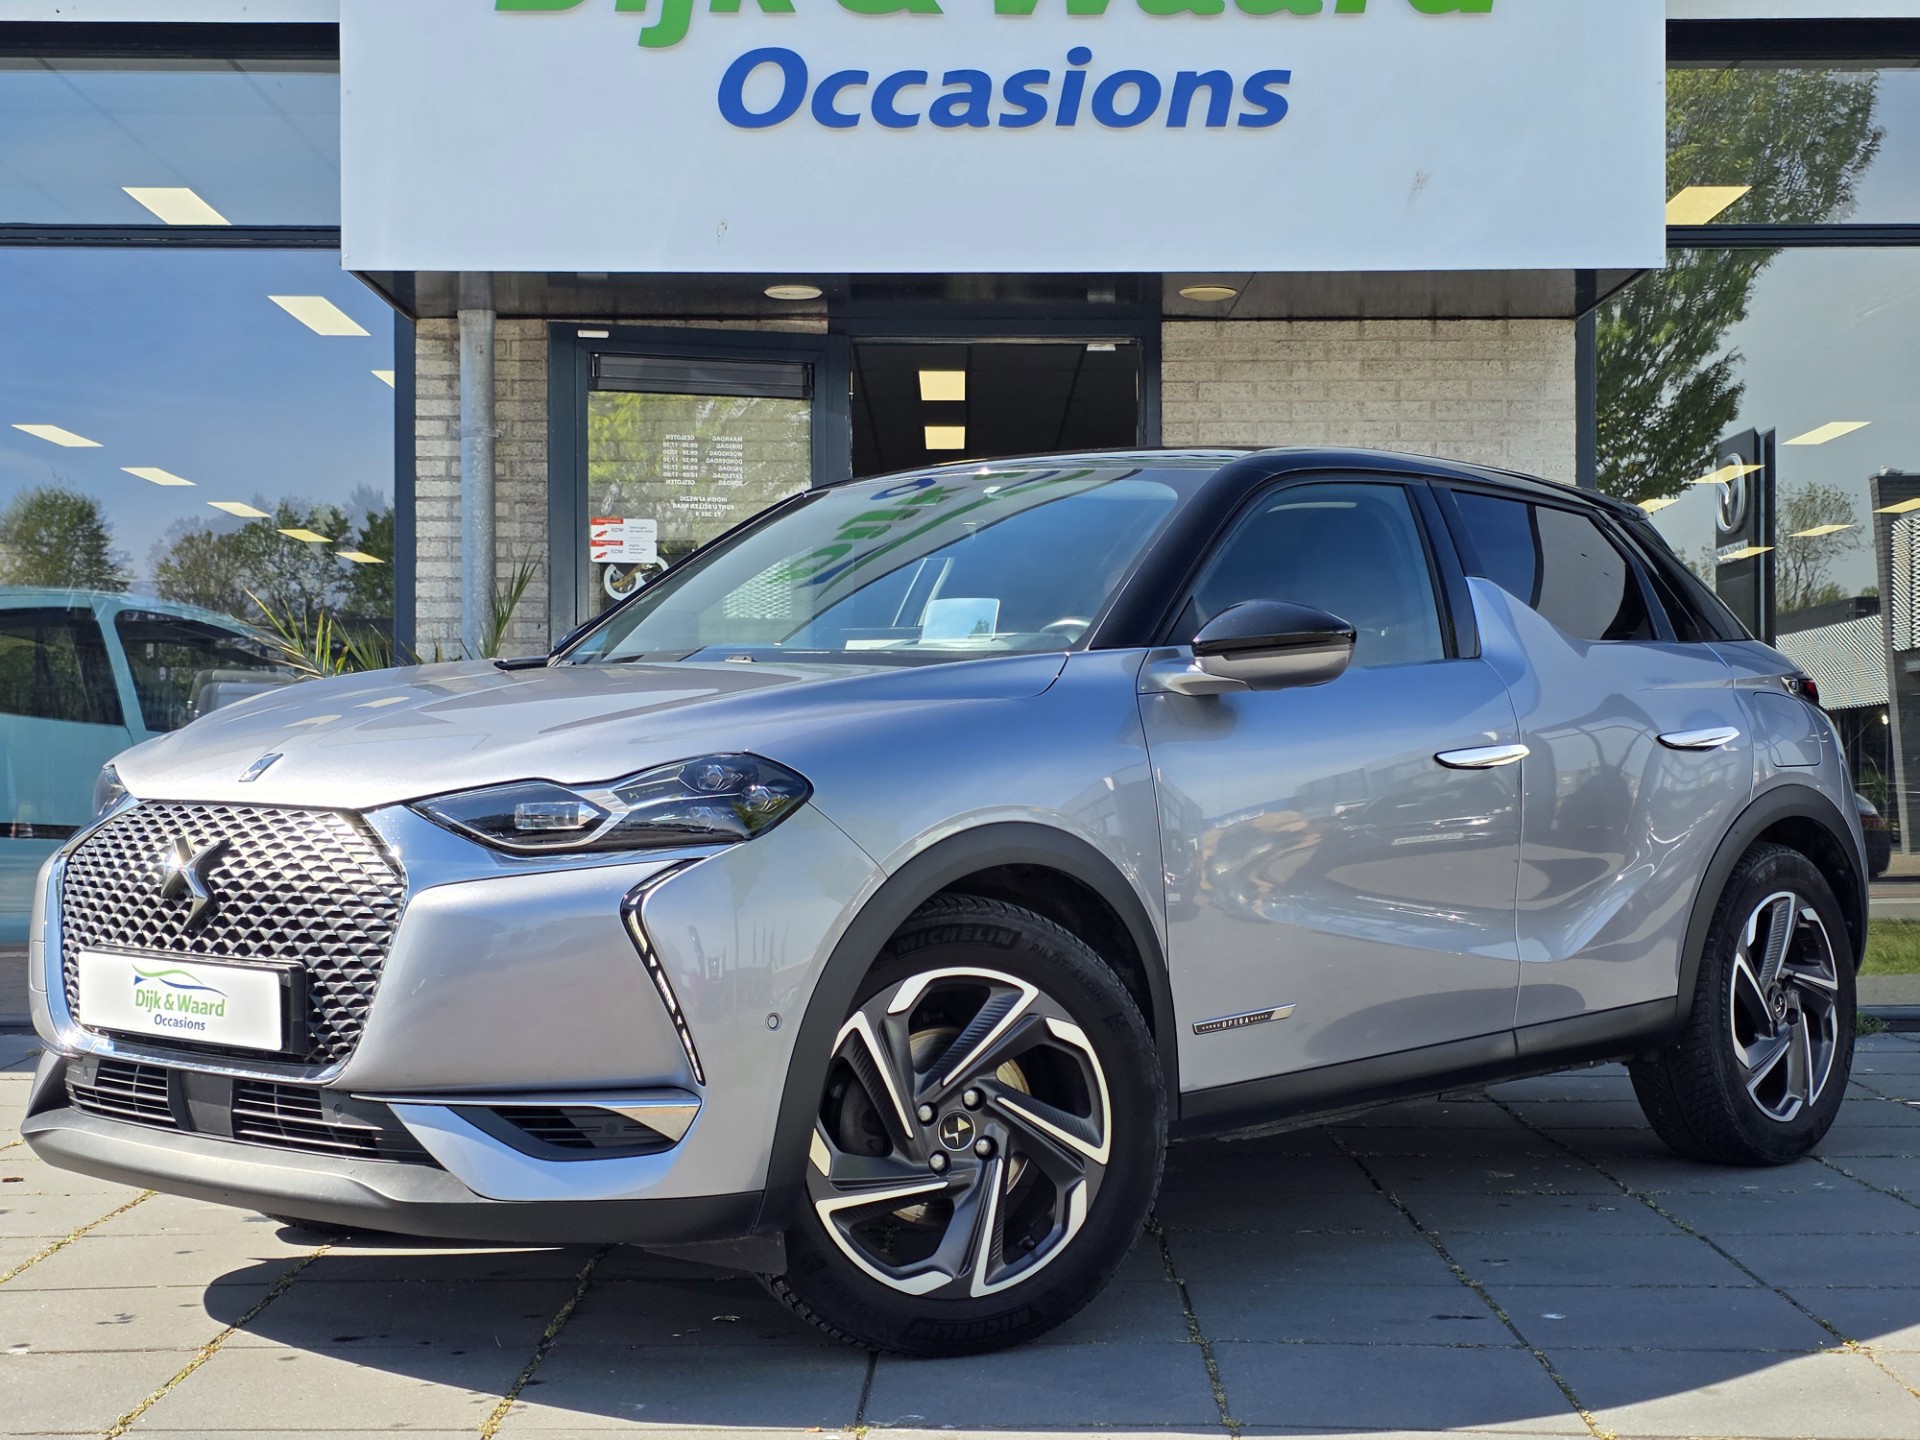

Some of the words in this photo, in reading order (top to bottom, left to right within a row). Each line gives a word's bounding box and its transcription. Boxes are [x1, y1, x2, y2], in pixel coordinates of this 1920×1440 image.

[717, 46, 1291, 128] Occasions
[897, 926, 1017, 955] MICHELIN
[135, 988, 161, 1012] Dijk
[164, 993, 174, 1010] &
[177, 994, 226, 1017] Waard
[154, 1014, 206, 1031] Occasions
